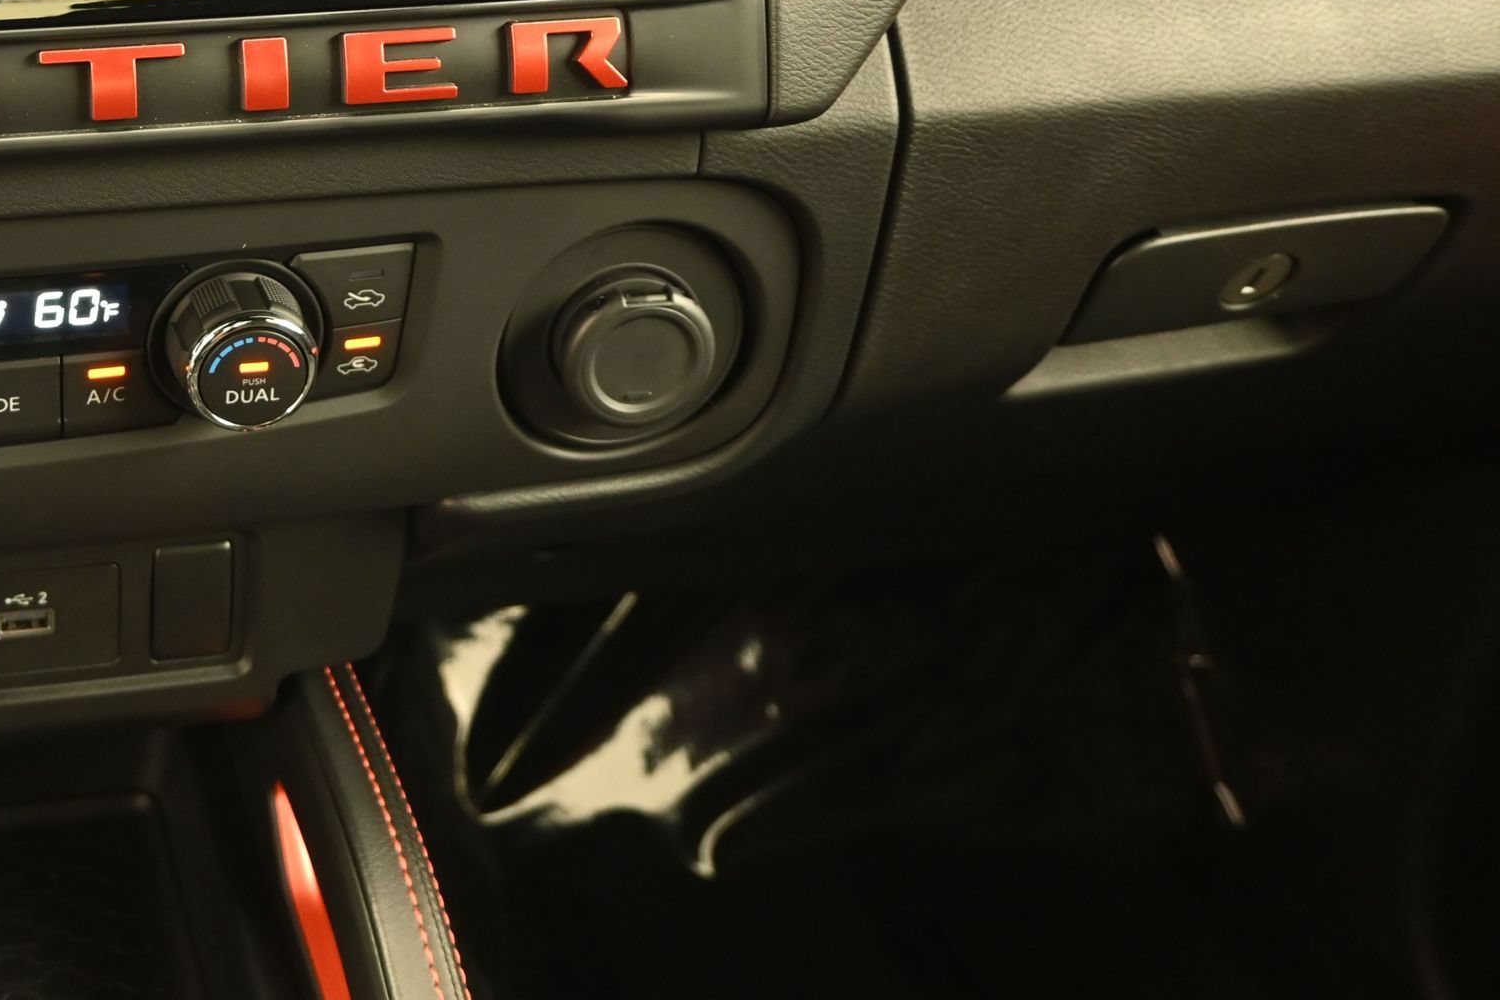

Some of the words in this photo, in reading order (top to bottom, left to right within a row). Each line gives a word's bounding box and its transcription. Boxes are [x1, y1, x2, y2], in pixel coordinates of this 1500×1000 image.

[241, 377, 267, 387] PUSH
[86, 387, 125, 405] A/C
[225, 388, 280, 405] DUAL
